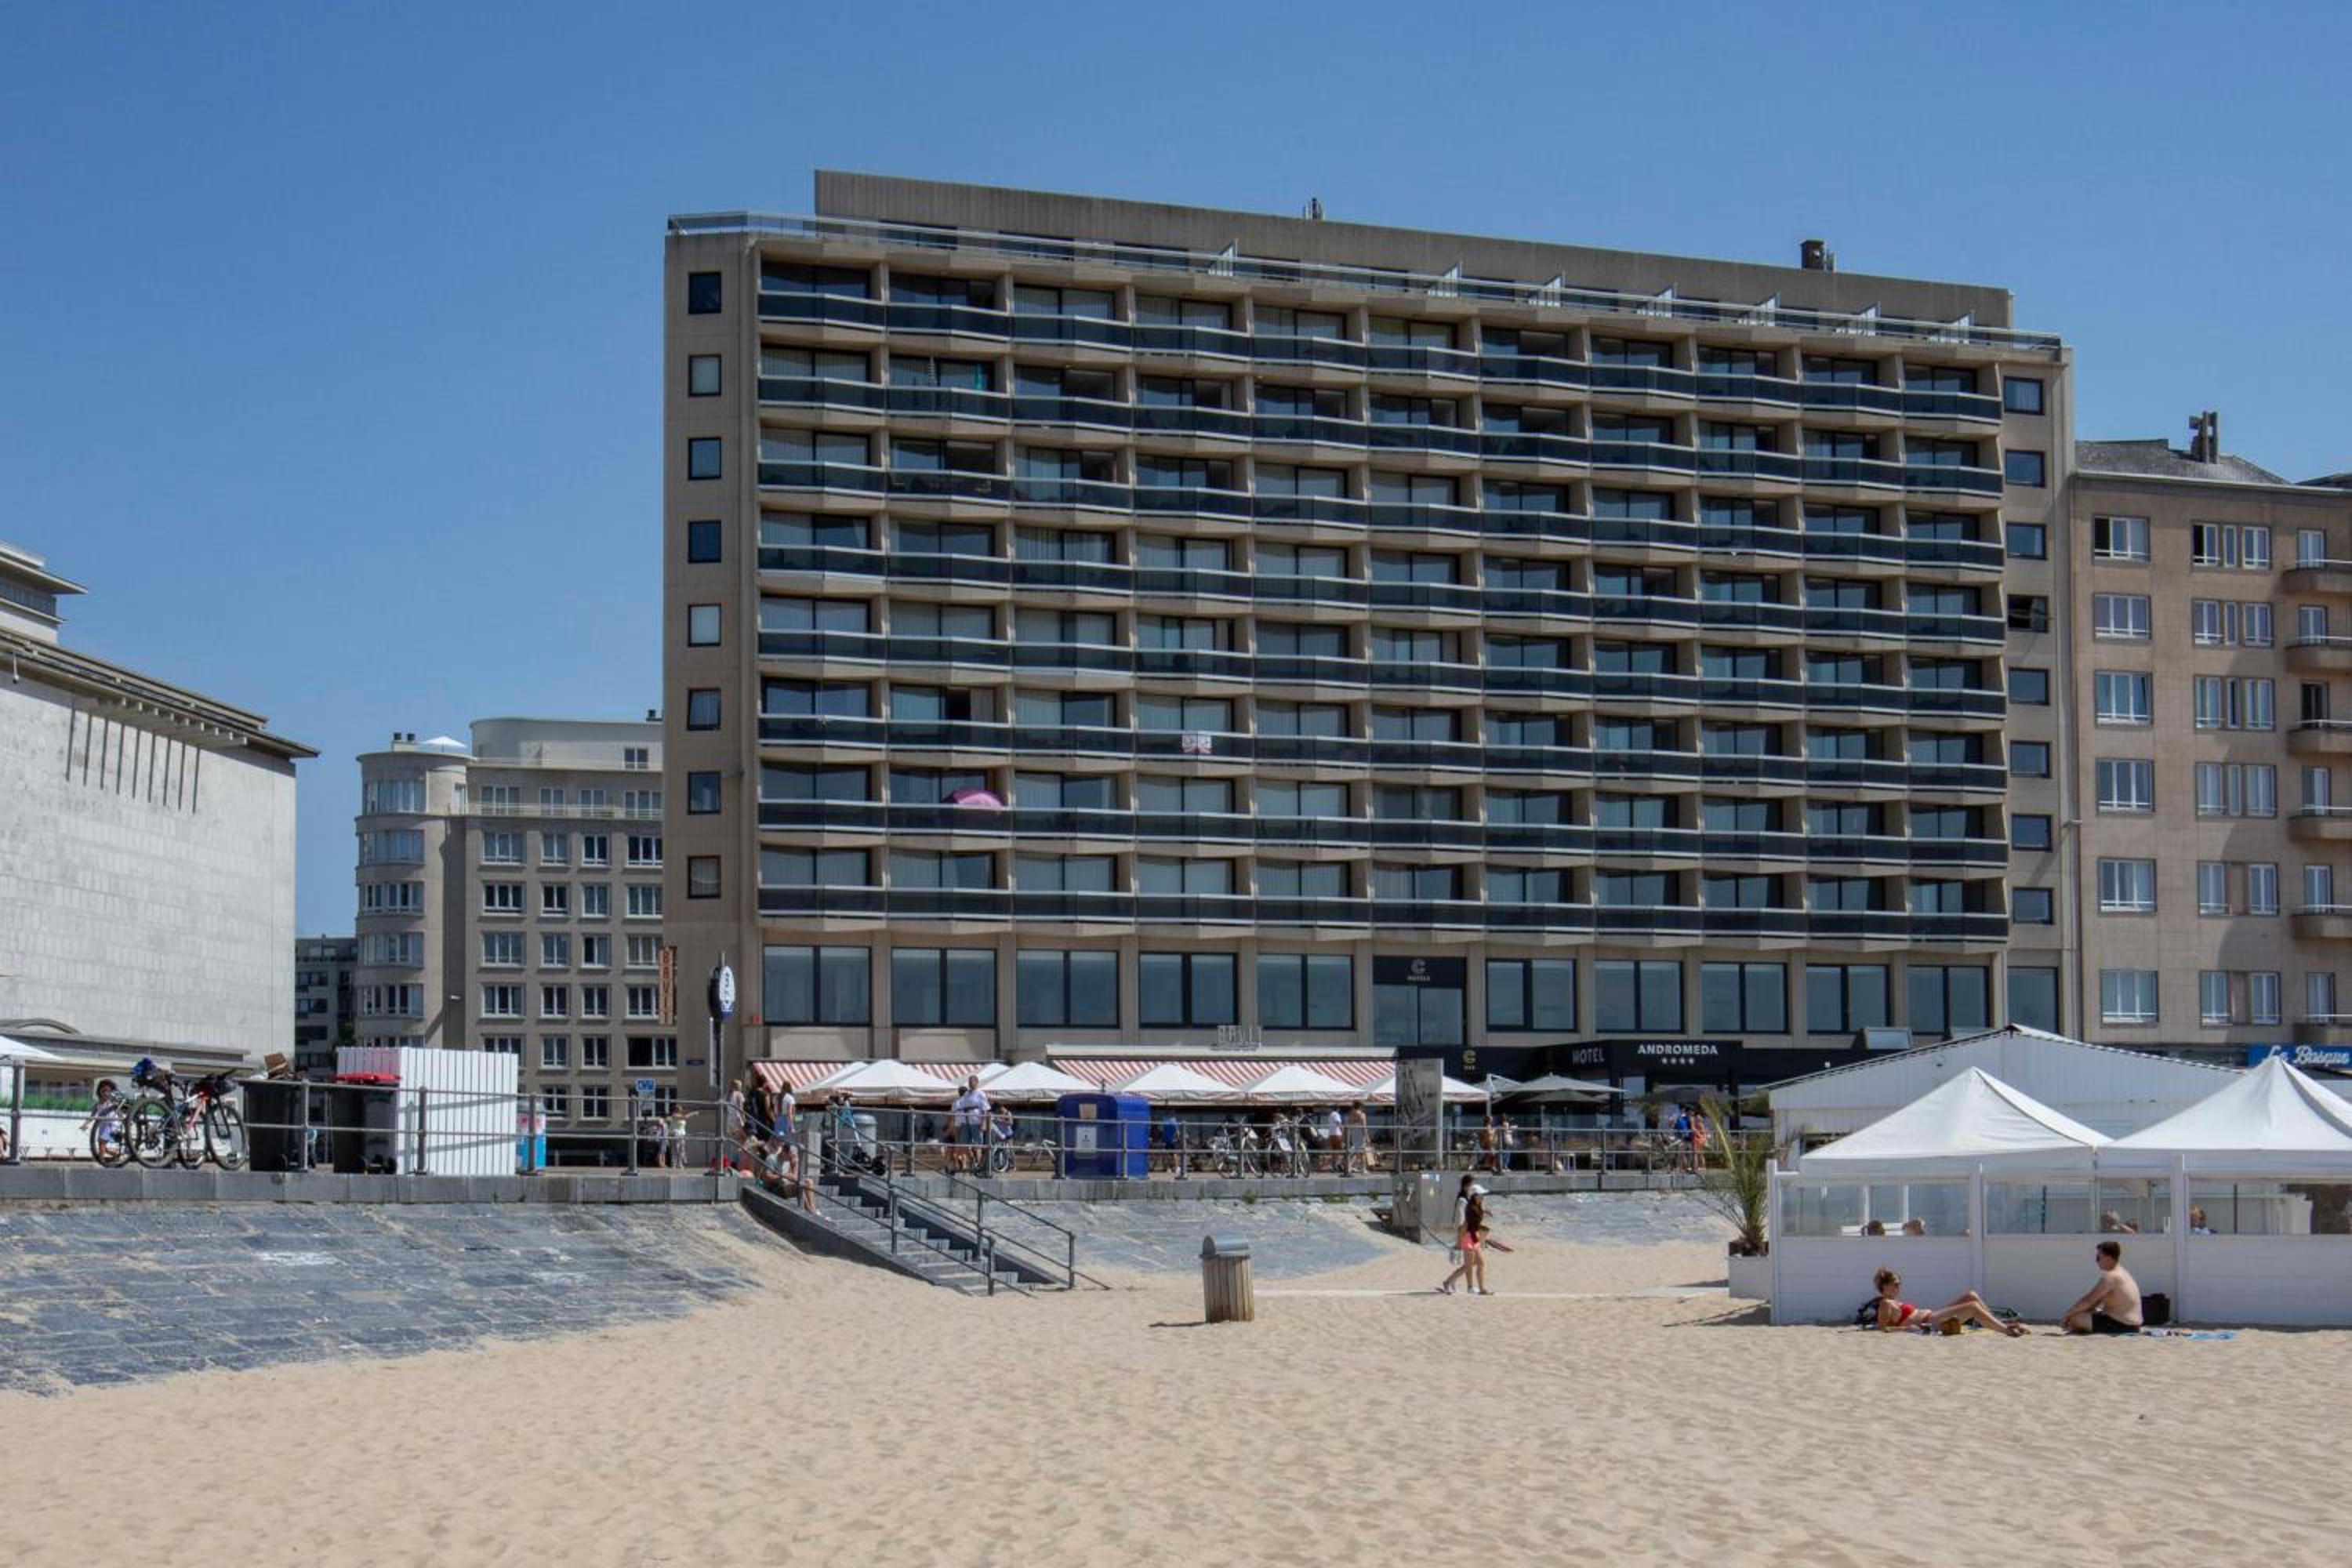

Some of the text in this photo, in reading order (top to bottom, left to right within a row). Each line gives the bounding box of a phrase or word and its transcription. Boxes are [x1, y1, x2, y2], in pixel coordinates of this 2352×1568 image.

[1571, 1047, 1606, 1065] HOTEL
[1638, 1044, 1719, 1054] ANDROMEDA
[2292, 1045, 2350, 1067] Basque
